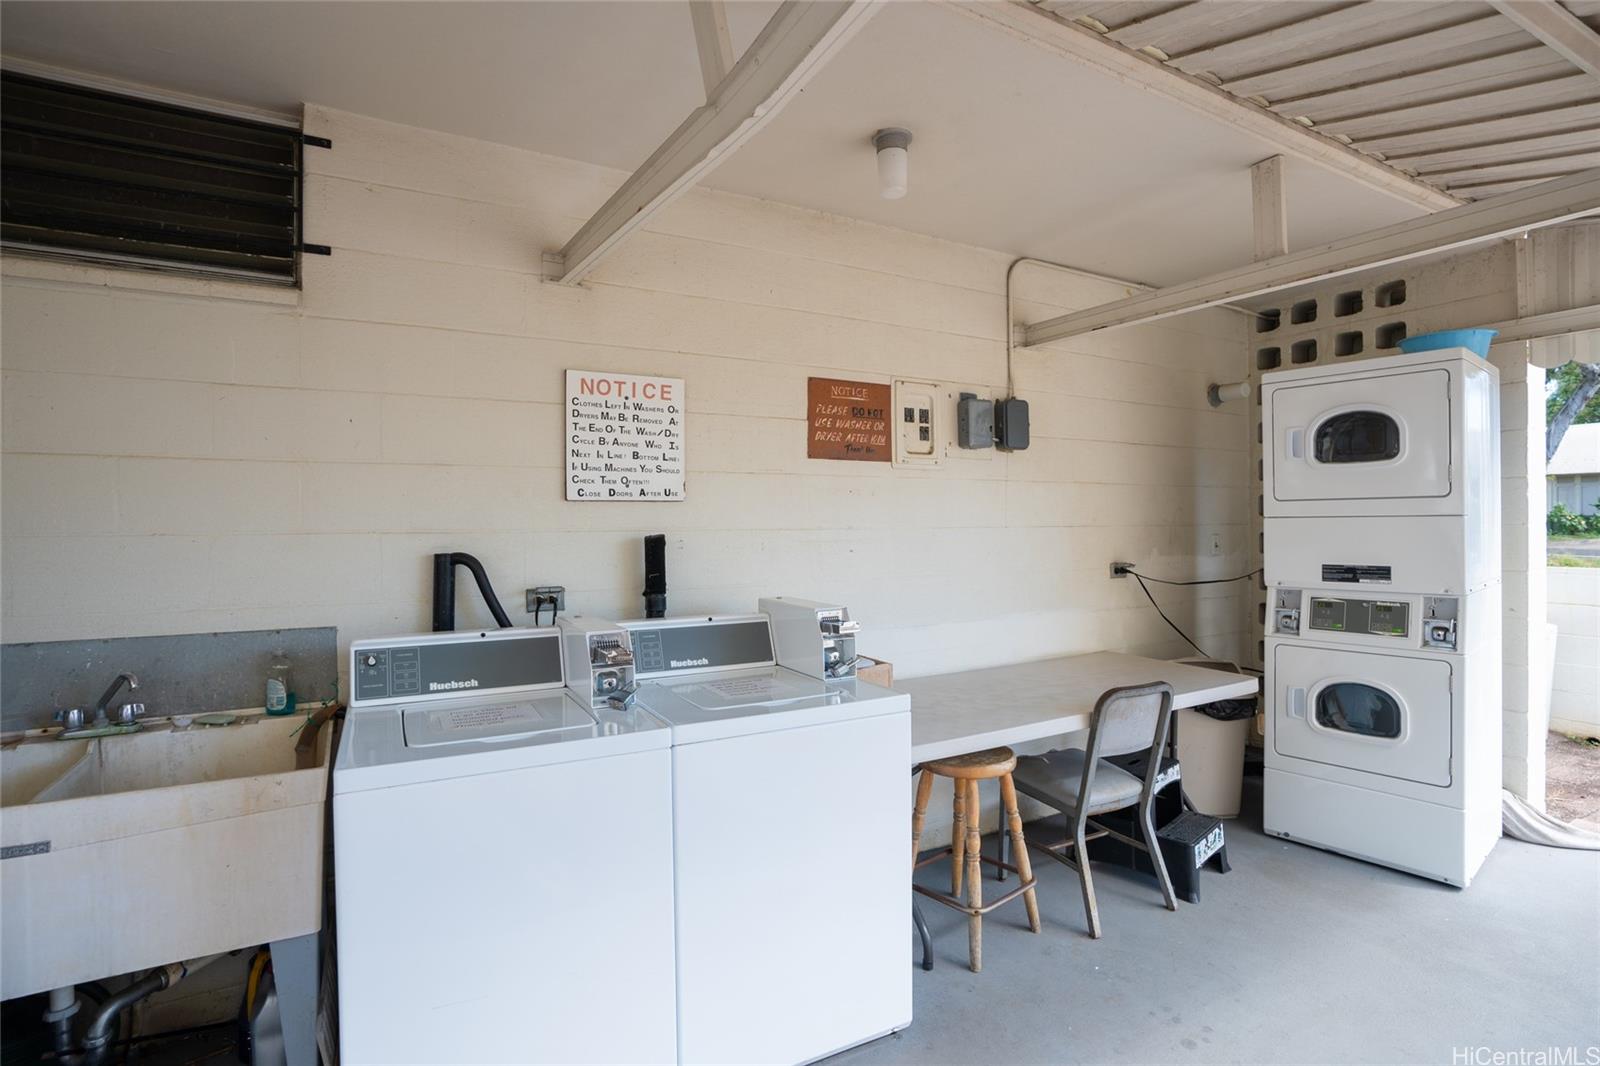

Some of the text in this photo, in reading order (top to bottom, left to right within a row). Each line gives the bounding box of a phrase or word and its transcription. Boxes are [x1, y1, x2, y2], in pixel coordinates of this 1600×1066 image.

[580, 377, 672, 401] NOTICE
[831, 385, 869, 399] NOTICE
[815, 404, 849, 416] PLEASE
[814, 418, 885, 432] USE WASHER OR
[814, 431, 843, 442] DRYER
[670, 657, 709, 668] Huebsch
[429, 679, 479, 691] Huebsch
